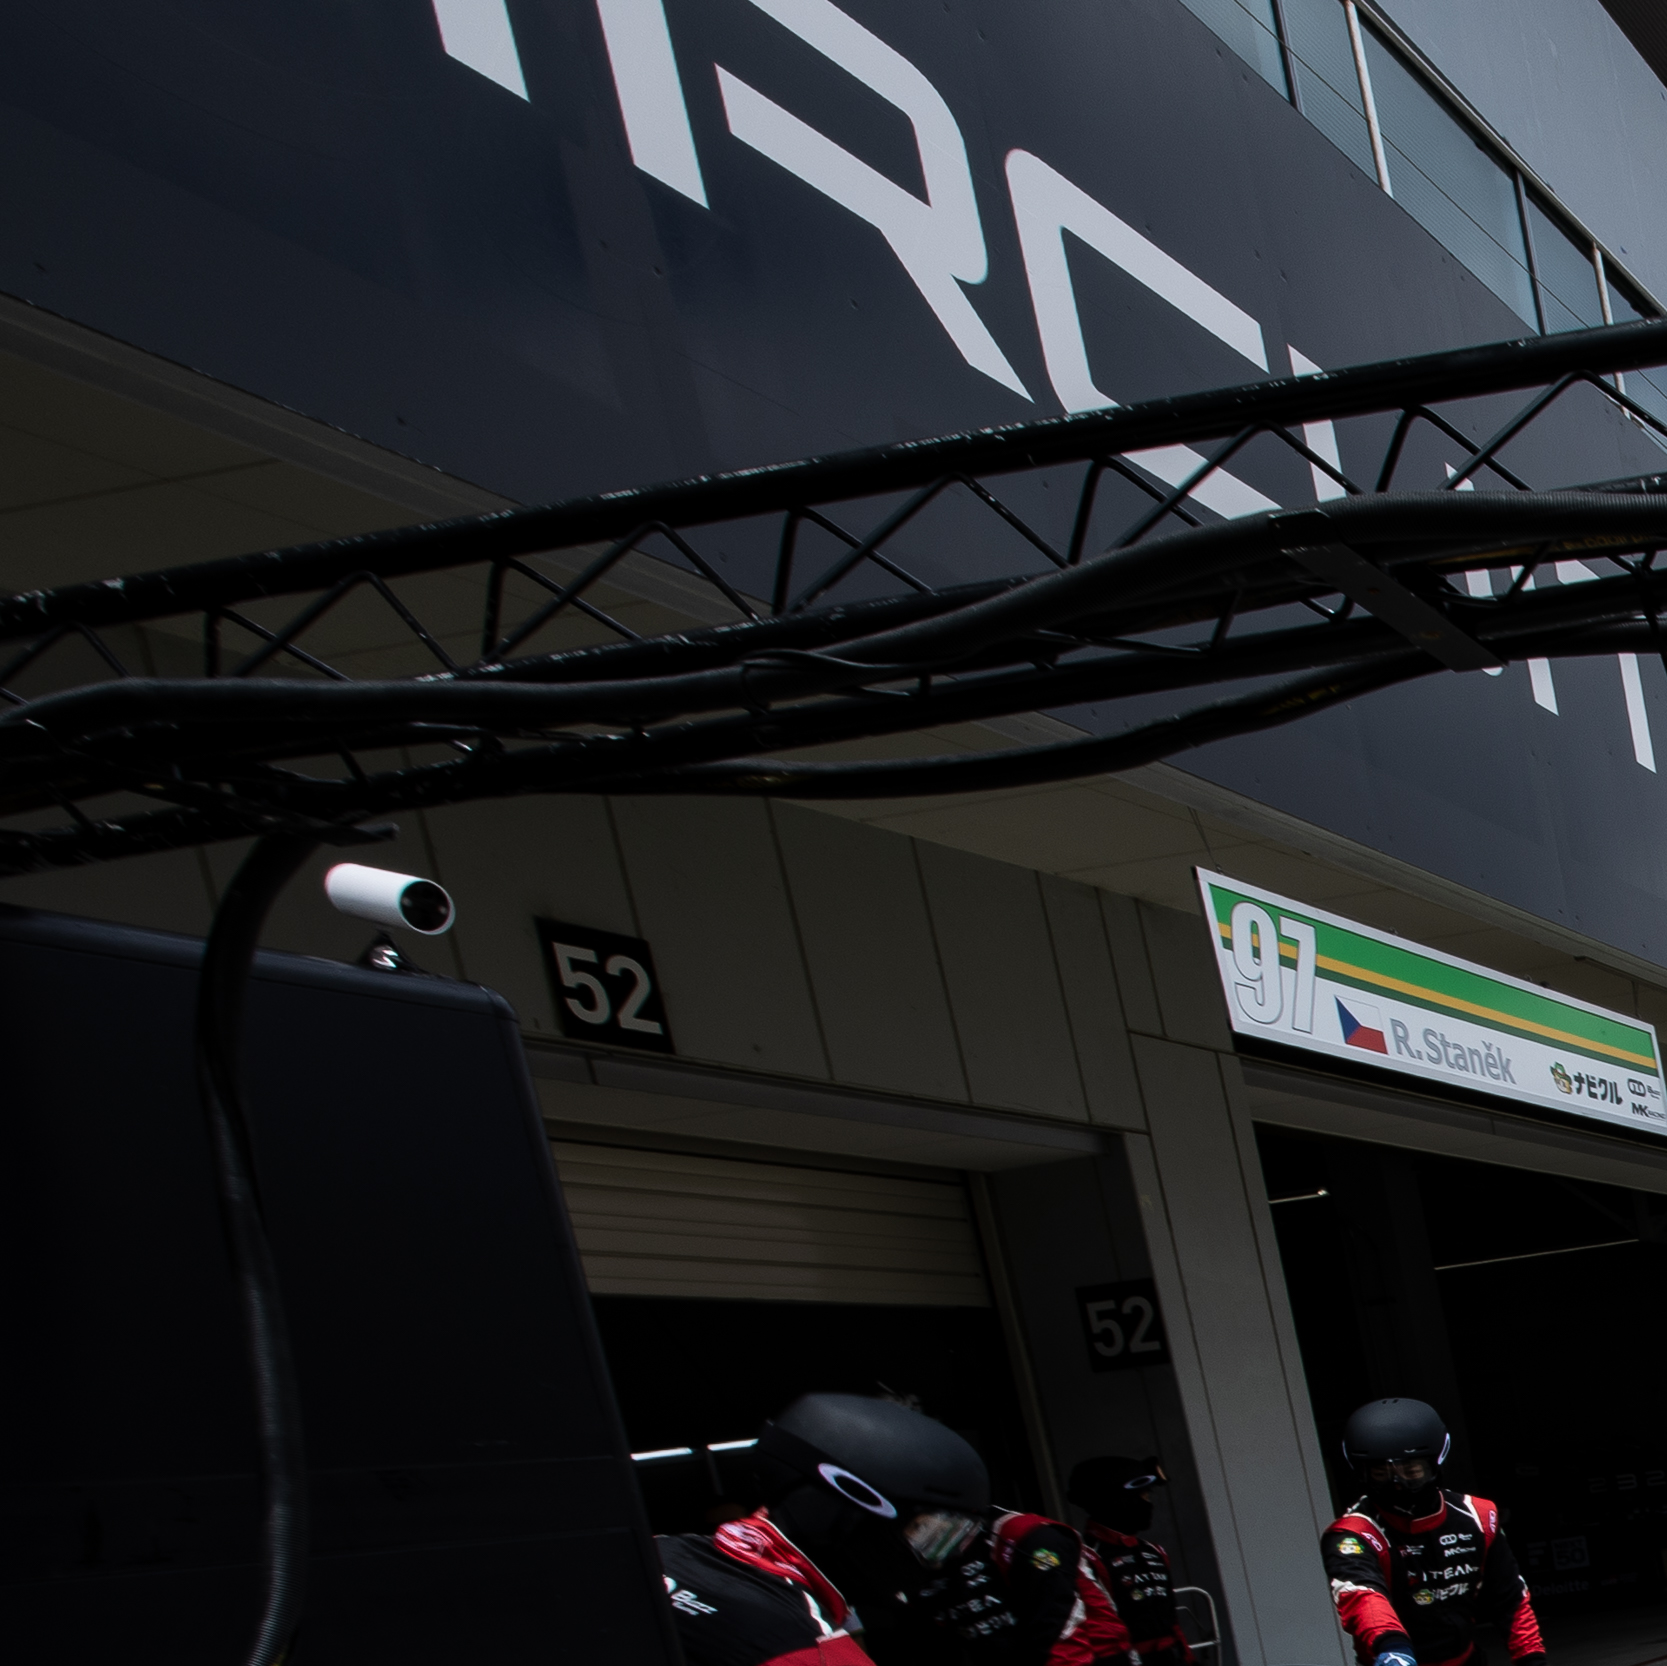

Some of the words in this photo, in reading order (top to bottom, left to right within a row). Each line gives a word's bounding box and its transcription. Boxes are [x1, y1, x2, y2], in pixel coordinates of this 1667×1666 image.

[552, 942, 663, 1034] 52
[1230, 901, 1316, 1034] 97
[1573, 1071, 1623, 1105] ナビクル
[1086, 1296, 1161, 1357] 52
